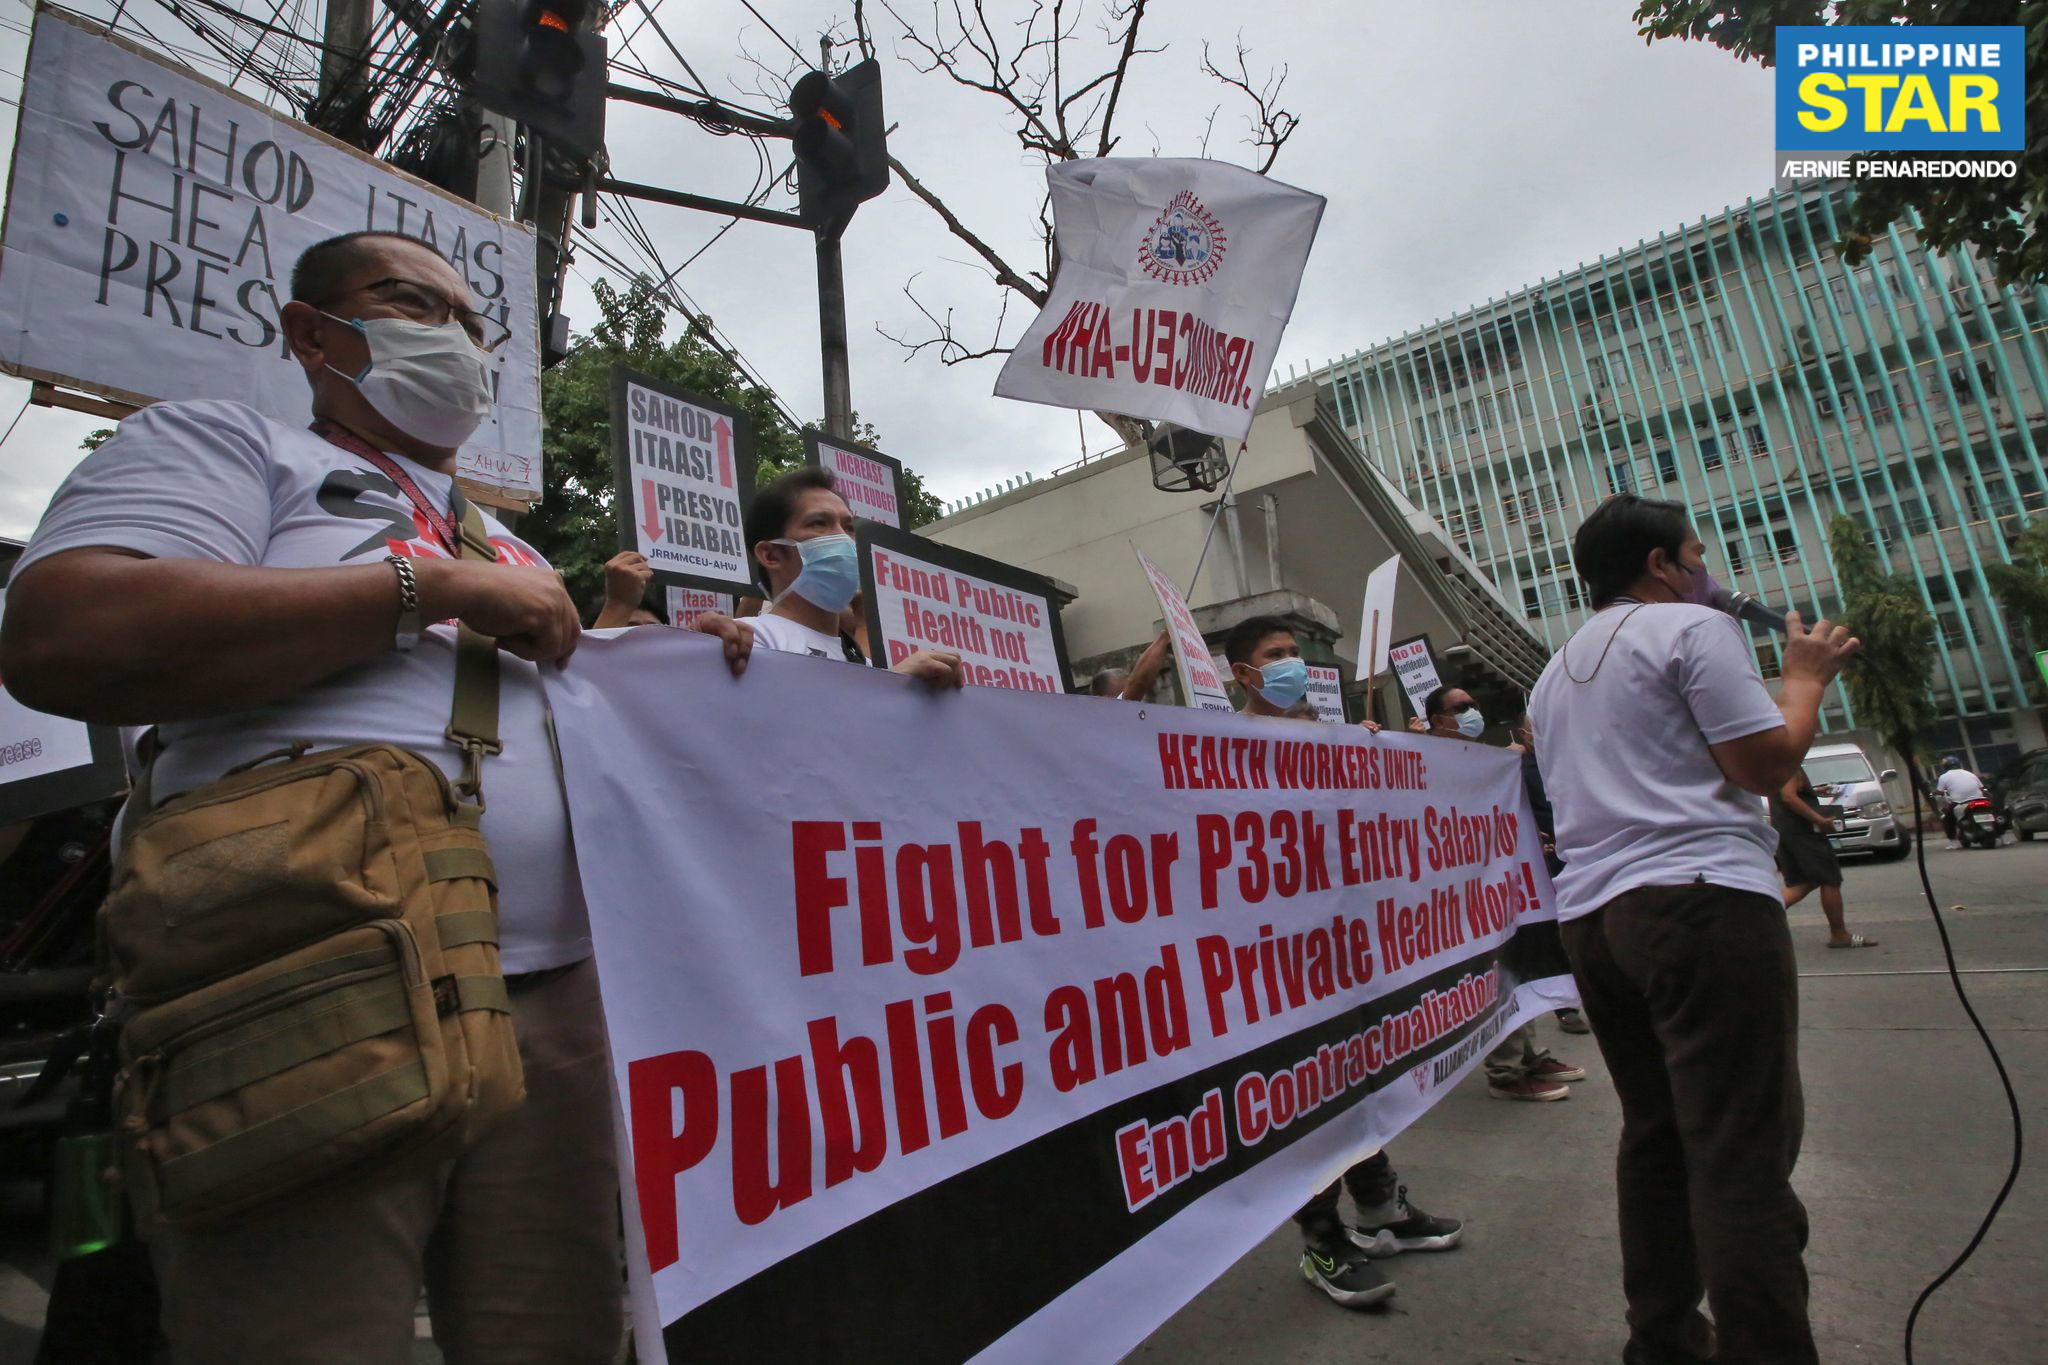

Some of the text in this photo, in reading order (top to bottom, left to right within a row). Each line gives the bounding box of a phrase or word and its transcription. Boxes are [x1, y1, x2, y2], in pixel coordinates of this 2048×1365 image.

[92, 80, 313, 213] SAHOD
[631, 388, 712, 443] SAHOD
[634, 429, 714, 483] ITAAS!
[835, 451, 884, 485] INCREASE
[657, 483, 739, 528] PRESYO
[830, 477, 896, 514] EALTH BUDGET
[649, 548, 737, 572] JRRMMCEU-AHW
[665, 517, 742, 557] IBABA!
[875, 551, 1040, 628] Fund Public
[902, 597, 1030, 665] Health not
[1391, 644, 1423, 662] No to
[1323, 670, 1336, 681] to
[1396, 655, 1430, 675] Confidential
[1405, 678, 1439, 696] Intelligence
[1158, 733, 1427, 790] HEALTH WORKERS UNITE:
[791, 805, 1518, 977] Fight for P33k Entry Salary for
[628, 990, 1024, 1275] Public
[1044, 945, 1191, 1093] and
[1196, 915, 1373, 1037] Private
[1377, 881, 1465, 974] Health
[1115, 1087, 1227, 1213] End
